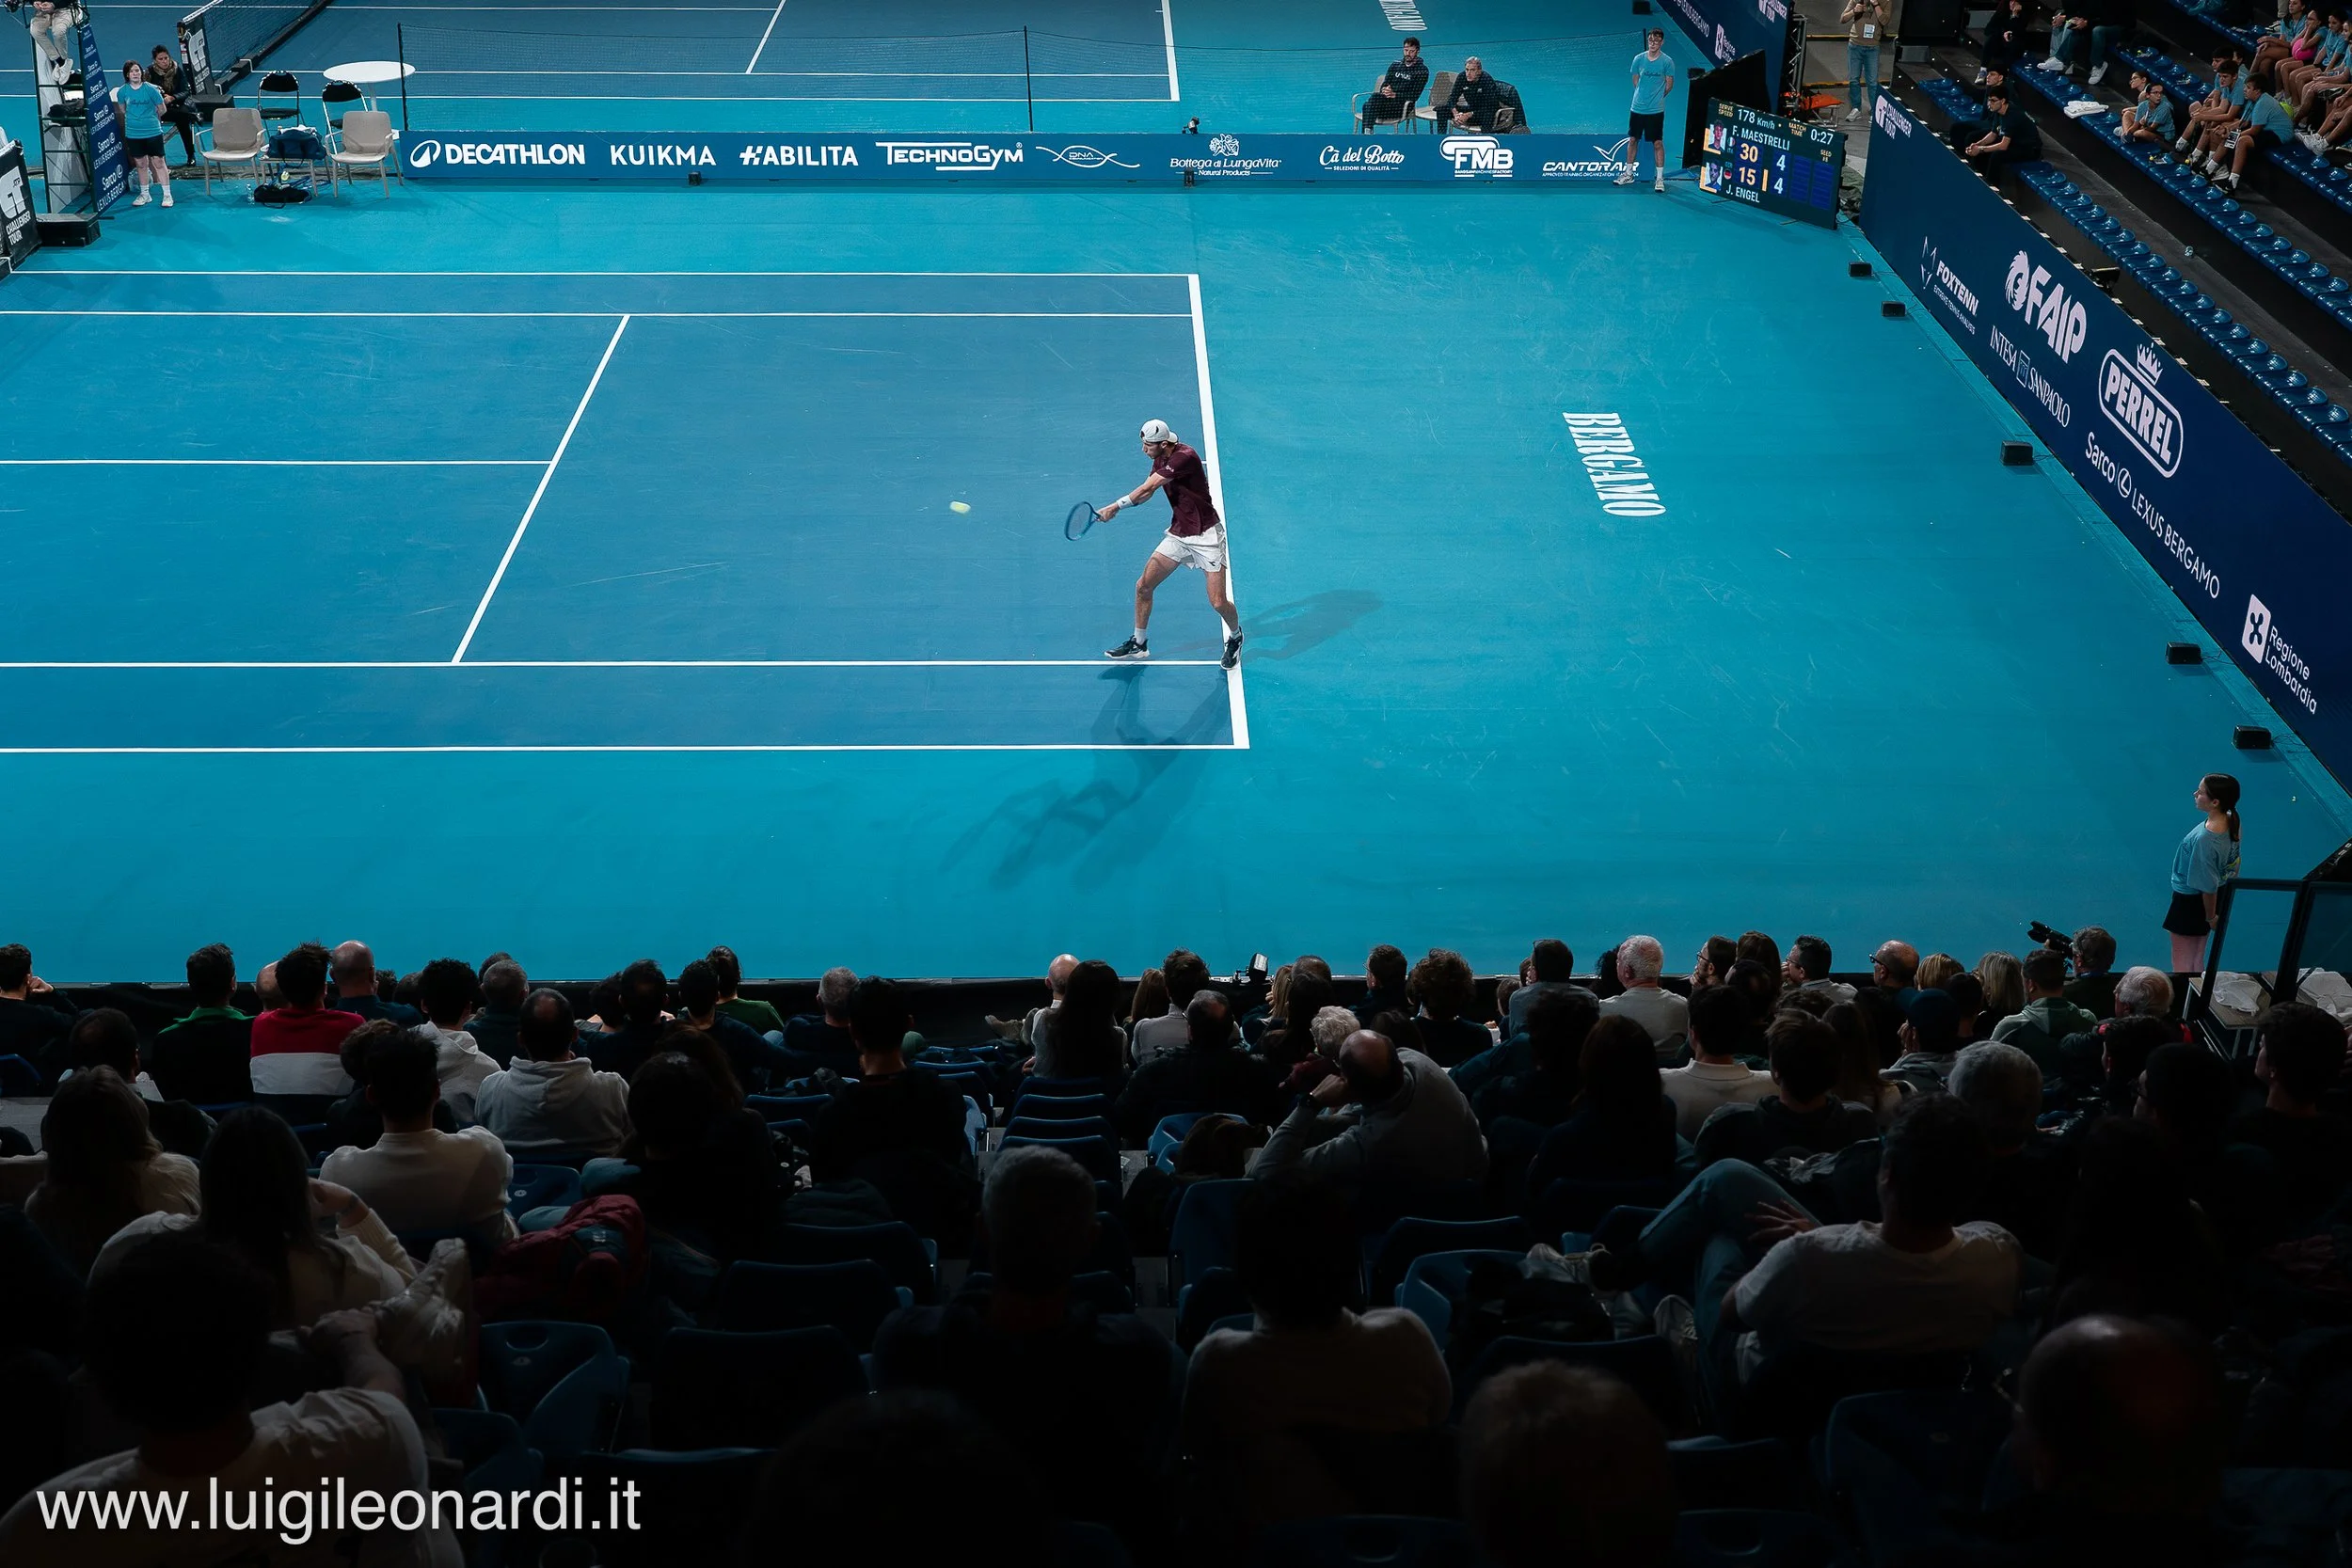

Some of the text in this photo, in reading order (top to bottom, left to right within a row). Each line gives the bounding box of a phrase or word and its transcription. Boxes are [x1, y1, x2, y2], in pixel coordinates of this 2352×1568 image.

[1378, 0, 1428, 30] ERGAMO
[1738, 109, 1756, 124] 178
[1884, 118, 1896, 139] TOUR
[1886, 103, 1912, 138] CHALLENGER
[98, 138, 110, 153] Sarco
[1732, 125, 1790, 150] F. MAESTRELLI
[1810, 129, 1834, 145] 0:27
[93, 141, 123, 169] LEXUS BERGAMO
[445, 144, 585, 166] DECATHLON
[610, 145, 716, 166] KUIKMA
[1169, 158, 1212, 170] Bottega
[1319, 144, 1405, 166] Cà del Botto
[1454, 148, 1514, 169] FMB
[1740, 143, 1786, 171] 30 4
[102, 172, 117, 191] Sarco
[1739, 166, 1784, 194] 15 4
[97, 181, 126, 212] LEXUS BERGA
[1725, 184, 1760, 203] J. ENGEL
[6, 211, 31, 235] CHALLENGER
[8, 230, 23, 245] TOUR
[2025, 264, 2087, 364] FAIP
[1990, 325, 2071, 428] INTESA SANPAOLO
[2104, 362, 2175, 465] PERREL
[1562, 412, 1667, 517] BERGAMO
[2085, 432, 2114, 483] Sarco
[2131, 488, 2164, 538] LEXUS
[2164, 523, 2220, 599] BERGAMO
[2269, 626, 2311, 681] Regione
[2265, 644, 2318, 716] Lombardia
